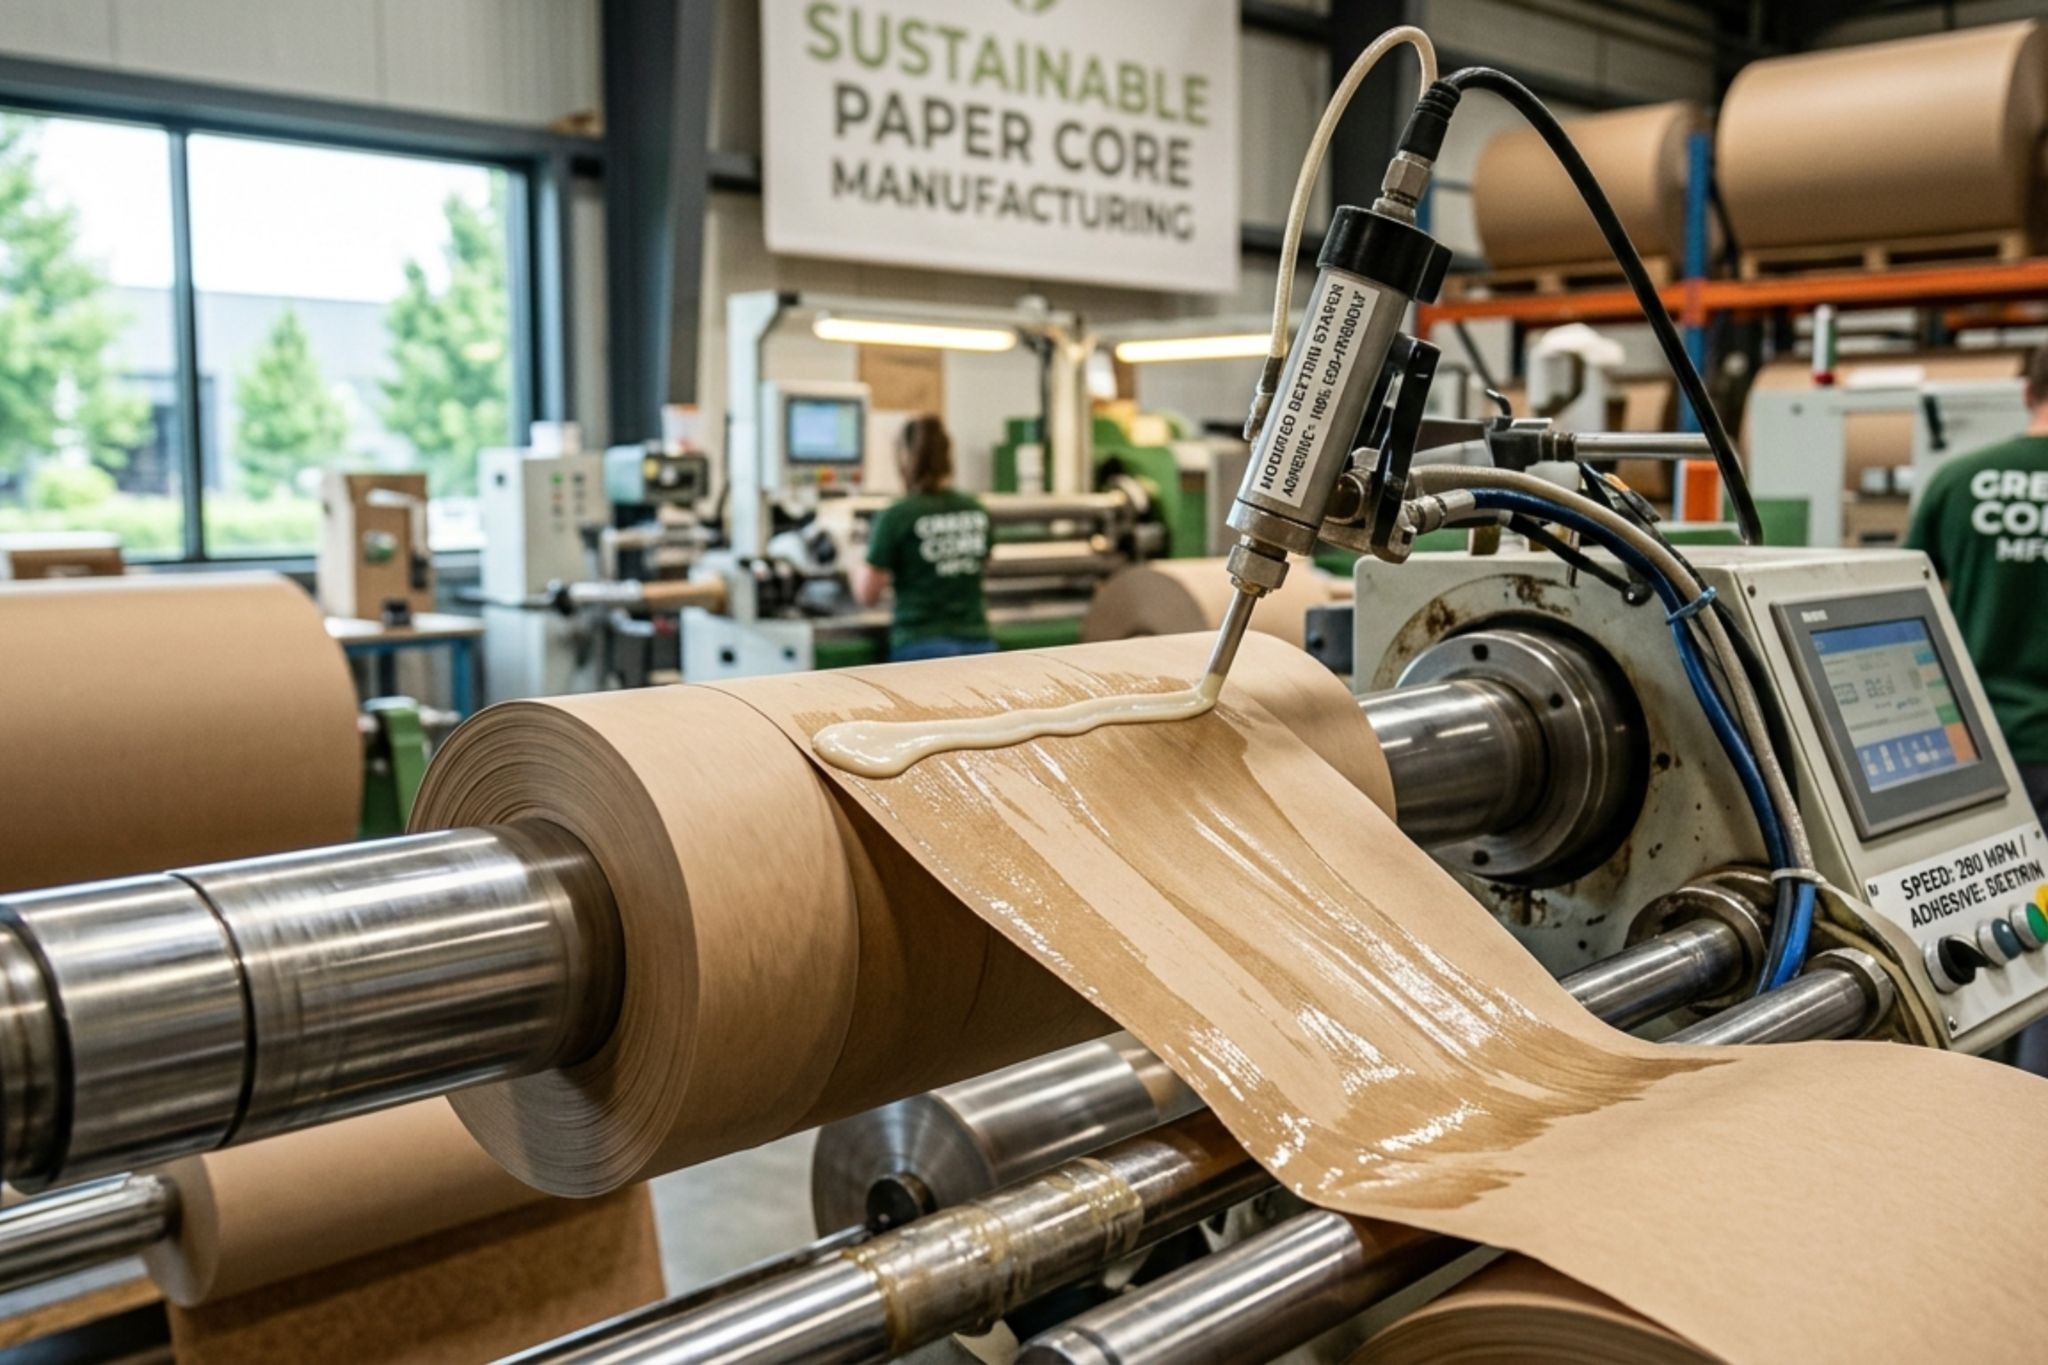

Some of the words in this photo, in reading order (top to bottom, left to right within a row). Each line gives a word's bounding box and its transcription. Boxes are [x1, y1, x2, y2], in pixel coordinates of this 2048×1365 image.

[806, 2, 1211, 127] SUSTAINABLE
[834, 82, 1033, 165] PAPER
[1053, 121, 1193, 188] CORE
[832, 158, 1194, 242] MANUFACTURING
[1971, 500, 2048, 536] CO
[1901, 866, 1955, 900] SPEED:
[1911, 883, 1986, 928] ADHESIVE:
